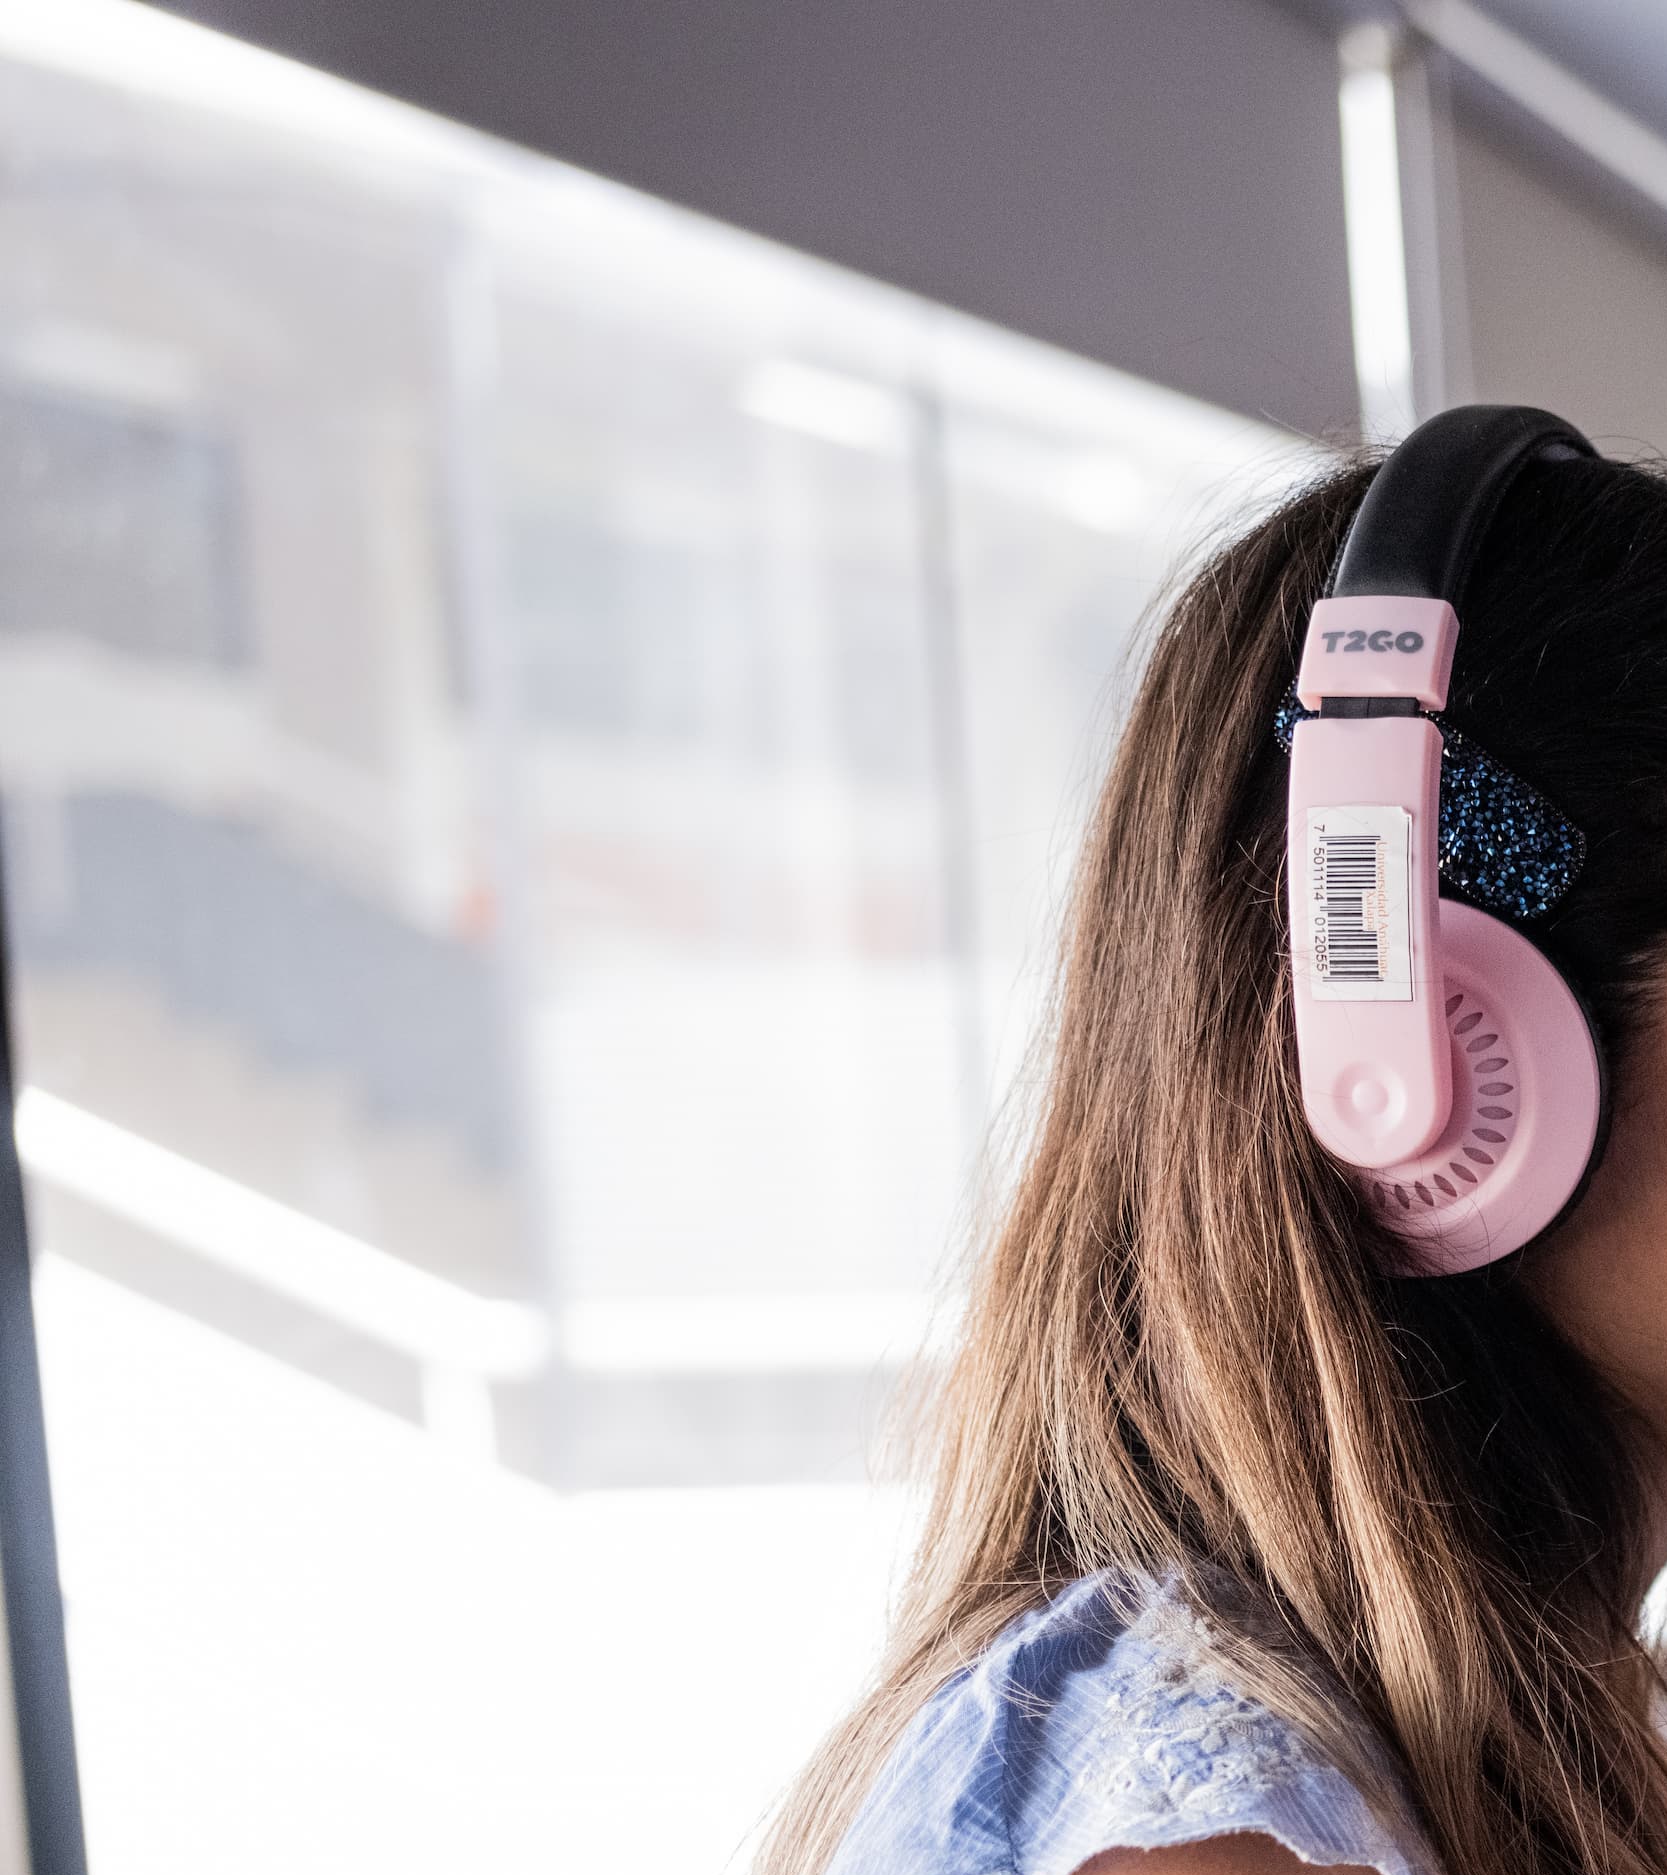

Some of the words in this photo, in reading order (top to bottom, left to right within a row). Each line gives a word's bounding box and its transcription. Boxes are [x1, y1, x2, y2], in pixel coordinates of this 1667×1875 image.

[1322, 630, 1424, 654] T2GO
[1313, 824, 1325, 833] 7
[1313, 847, 1325, 901] 501114
[1377, 842, 1389, 917] Universidad
[1314, 917, 1328, 972] 012055
